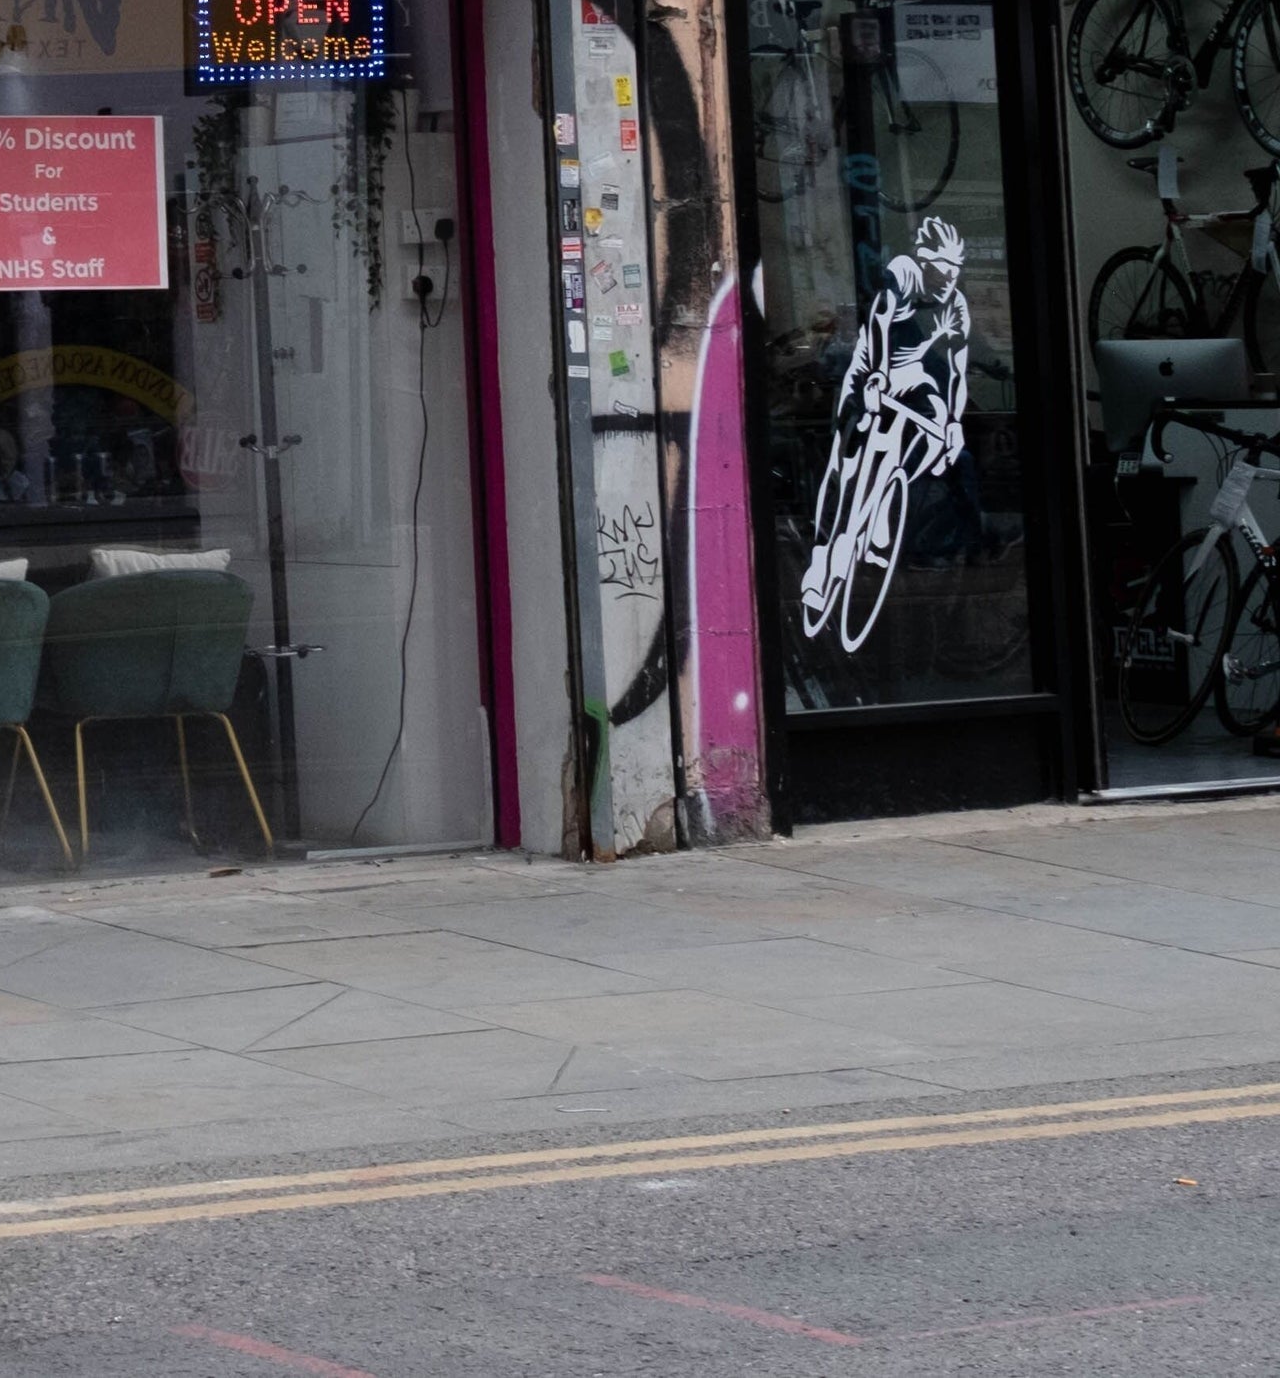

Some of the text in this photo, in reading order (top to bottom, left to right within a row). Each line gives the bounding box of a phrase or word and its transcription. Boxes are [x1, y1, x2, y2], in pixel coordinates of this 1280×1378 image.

[211, 29, 372, 65] Welcome
[25, 127, 137, 151] Discount
[34, 163, 64, 179] For
[0, 193, 99, 212] Students
[41, 226, 57, 245] &
[52, 258, 105, 278] Staff
